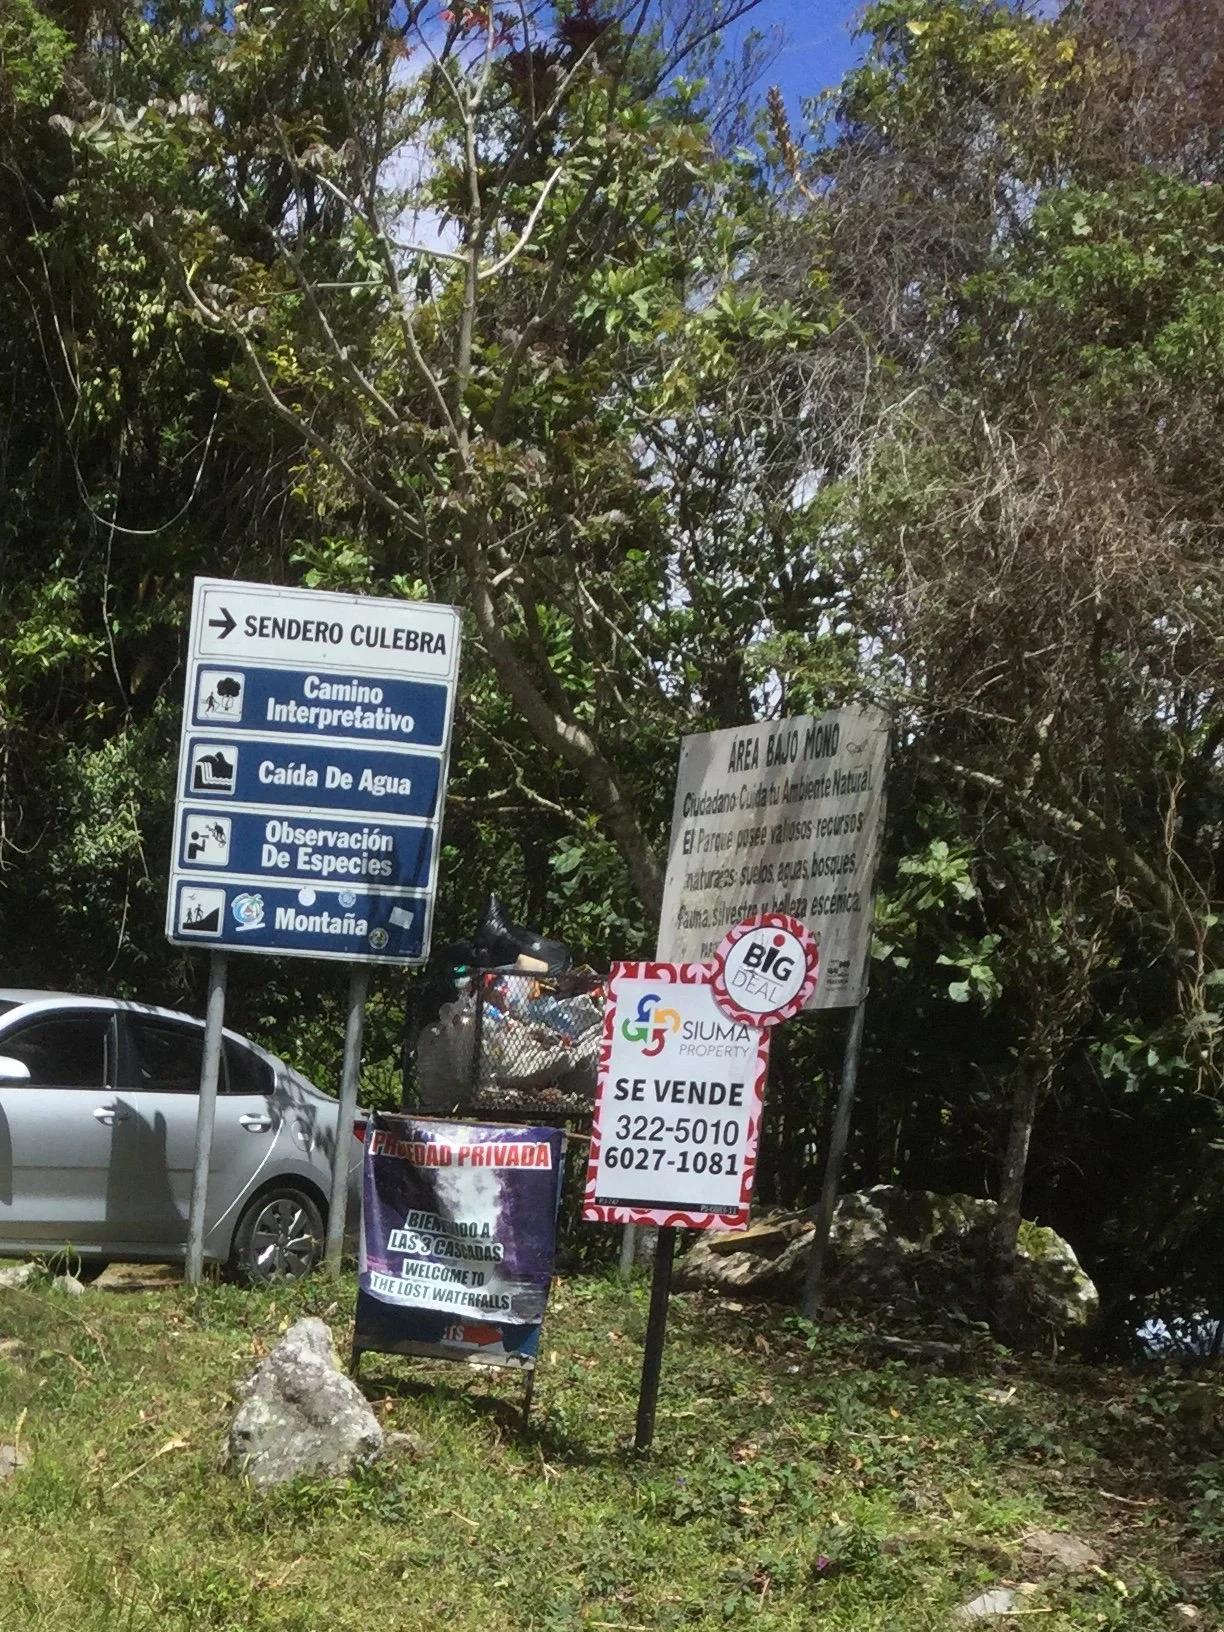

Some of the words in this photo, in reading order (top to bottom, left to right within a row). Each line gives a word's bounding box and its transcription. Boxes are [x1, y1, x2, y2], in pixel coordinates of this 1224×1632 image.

[243, 614, 344, 645] SENDERO
[350, 623, 447, 655] CULEBRA
[303, 675, 383, 705] Camino
[266, 698, 415, 733] Interpretativo
[728, 735, 759, 773] ÁREA
[766, 730, 798, 767] BAJO
[804, 722, 840, 761] MONO
[258, 761, 318, 788] Caída
[325, 767, 354, 790] De
[358, 769, 411, 796] Agua
[740, 783, 767, 810] Cuida
[783, 776, 832, 804] Ambiente
[265, 821, 394, 852] Observación
[683, 829, 695, 855] El
[698, 829, 733, 857] Parque
[736, 826, 767, 855] posee
[771, 817, 813, 845] valiosos
[816, 811, 864, 839] recursos
[261, 844, 290, 868] De
[297, 847, 393, 877] Especies
[274, 907, 368, 936] Montaña
[742, 934, 796, 982] BIG
[731, 968, 778, 1005] DEAL
[682, 1020, 751, 1043] SIUMA
[679, 1043, 751, 1058] PROPERTY
[614, 1078, 646, 1101] SE
[654, 1079, 745, 1107] VENDE
[615, 1115, 740, 1146] 322-5010
[458, 1143, 549, 1168] PRIVADA
[604, 1147, 739, 1176] 6027-1081
[480, 1222, 491, 1239] A
[390, 1232, 417, 1250] LAS
[420, 1237, 432, 1253] 3
[433, 1239, 502, 1262] CASCADAS
[404, 1261, 470, 1285] WELCOME
[471, 1271, 485, 1287] TO
[372, 1274, 395, 1293] THE
[397, 1282, 430, 1299] LOST
[432, 1287, 510, 1310] WATERFALLS
